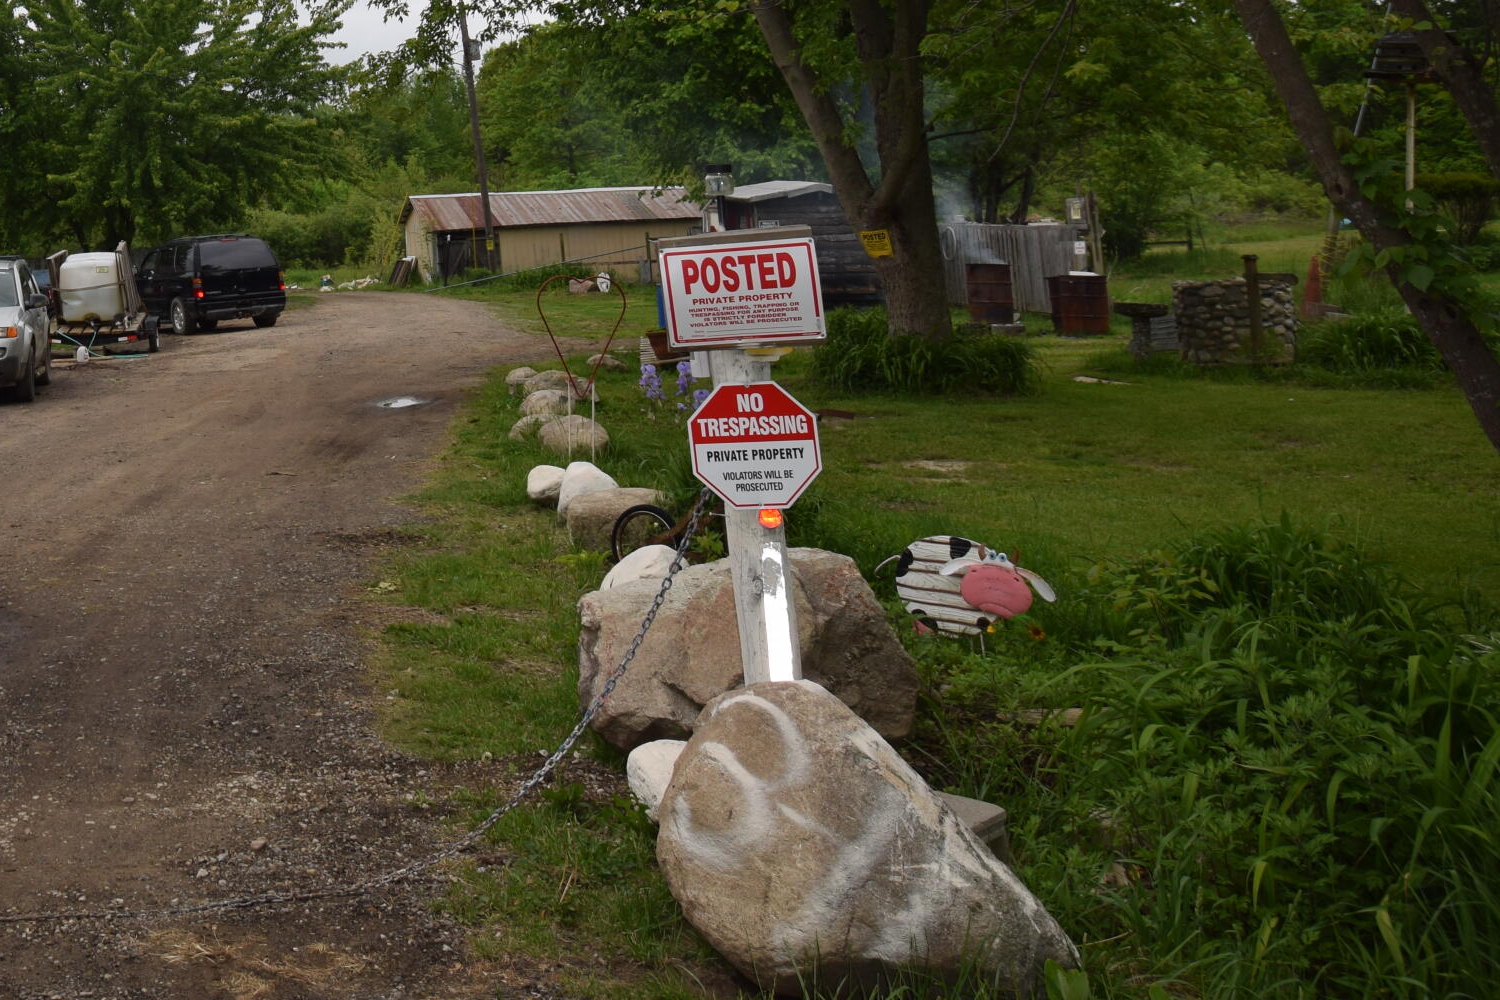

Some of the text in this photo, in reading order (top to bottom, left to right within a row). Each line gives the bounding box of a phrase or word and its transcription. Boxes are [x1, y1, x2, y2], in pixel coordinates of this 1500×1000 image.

[681, 252, 796, 295] POSTED
[692, 292, 792, 305] PRIVATE PROPERTY
[736, 392, 764, 412] NO
[697, 414, 808, 437] TRESPASSING
[707, 448, 804, 462] PRIVATE PROPERTY
[723, 470, 794, 480] VIOLATORS WILL BE
[736, 482, 783, 492] PROSECUTED
